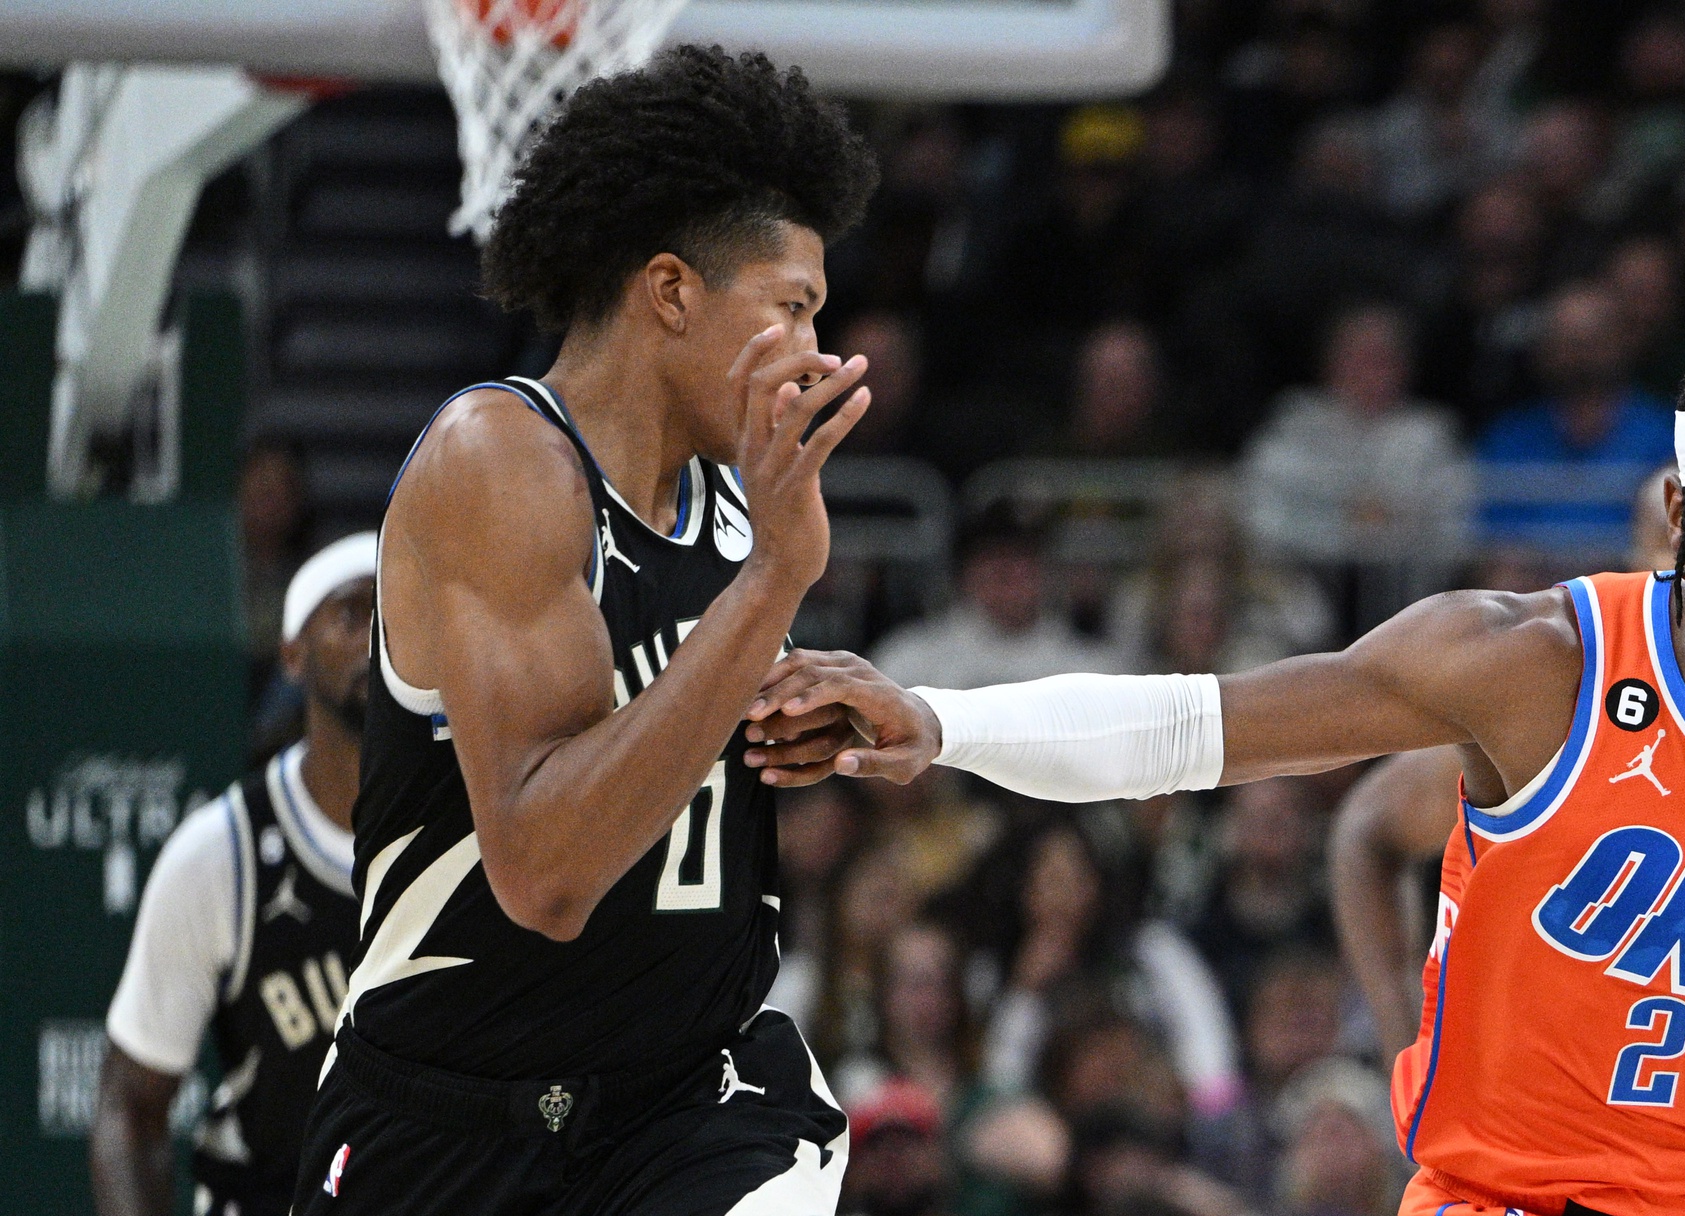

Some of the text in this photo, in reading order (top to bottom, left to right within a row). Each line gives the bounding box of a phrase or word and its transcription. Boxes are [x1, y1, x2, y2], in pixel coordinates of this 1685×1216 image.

[1617, 686, 1648, 726] 6
[27, 787, 207, 848] ULTR
[656, 760, 727, 911] 0
[259, 951, 347, 1050] BU
